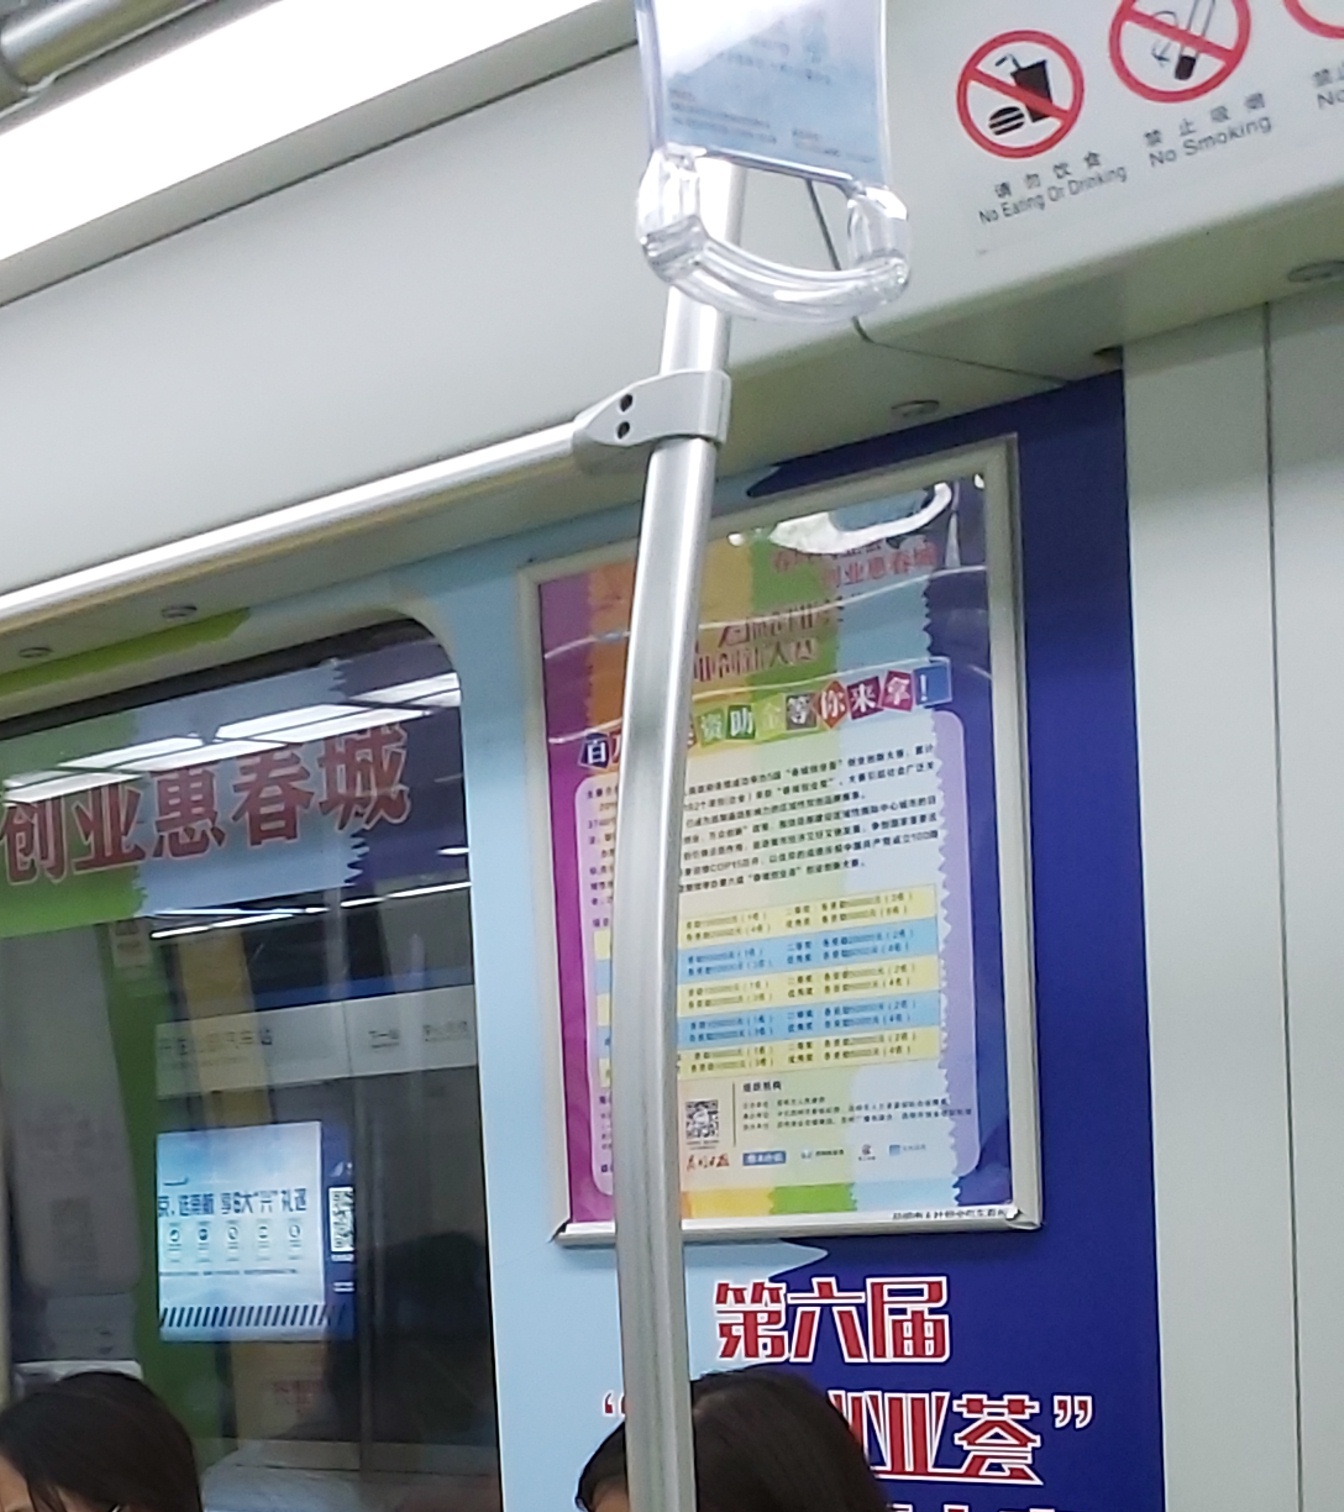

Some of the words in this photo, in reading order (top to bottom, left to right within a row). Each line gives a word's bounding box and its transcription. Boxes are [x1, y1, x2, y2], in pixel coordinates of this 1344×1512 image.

[1148, 150, 1177, 168] No
[1182, 114, 1272, 157] Smoking
[978, 209, 999, 224] No
[1001, 195, 1046, 217] Eating
[1068, 166, 1127, 195] Drinking
[714, 1276, 950, 1364] 第六届
